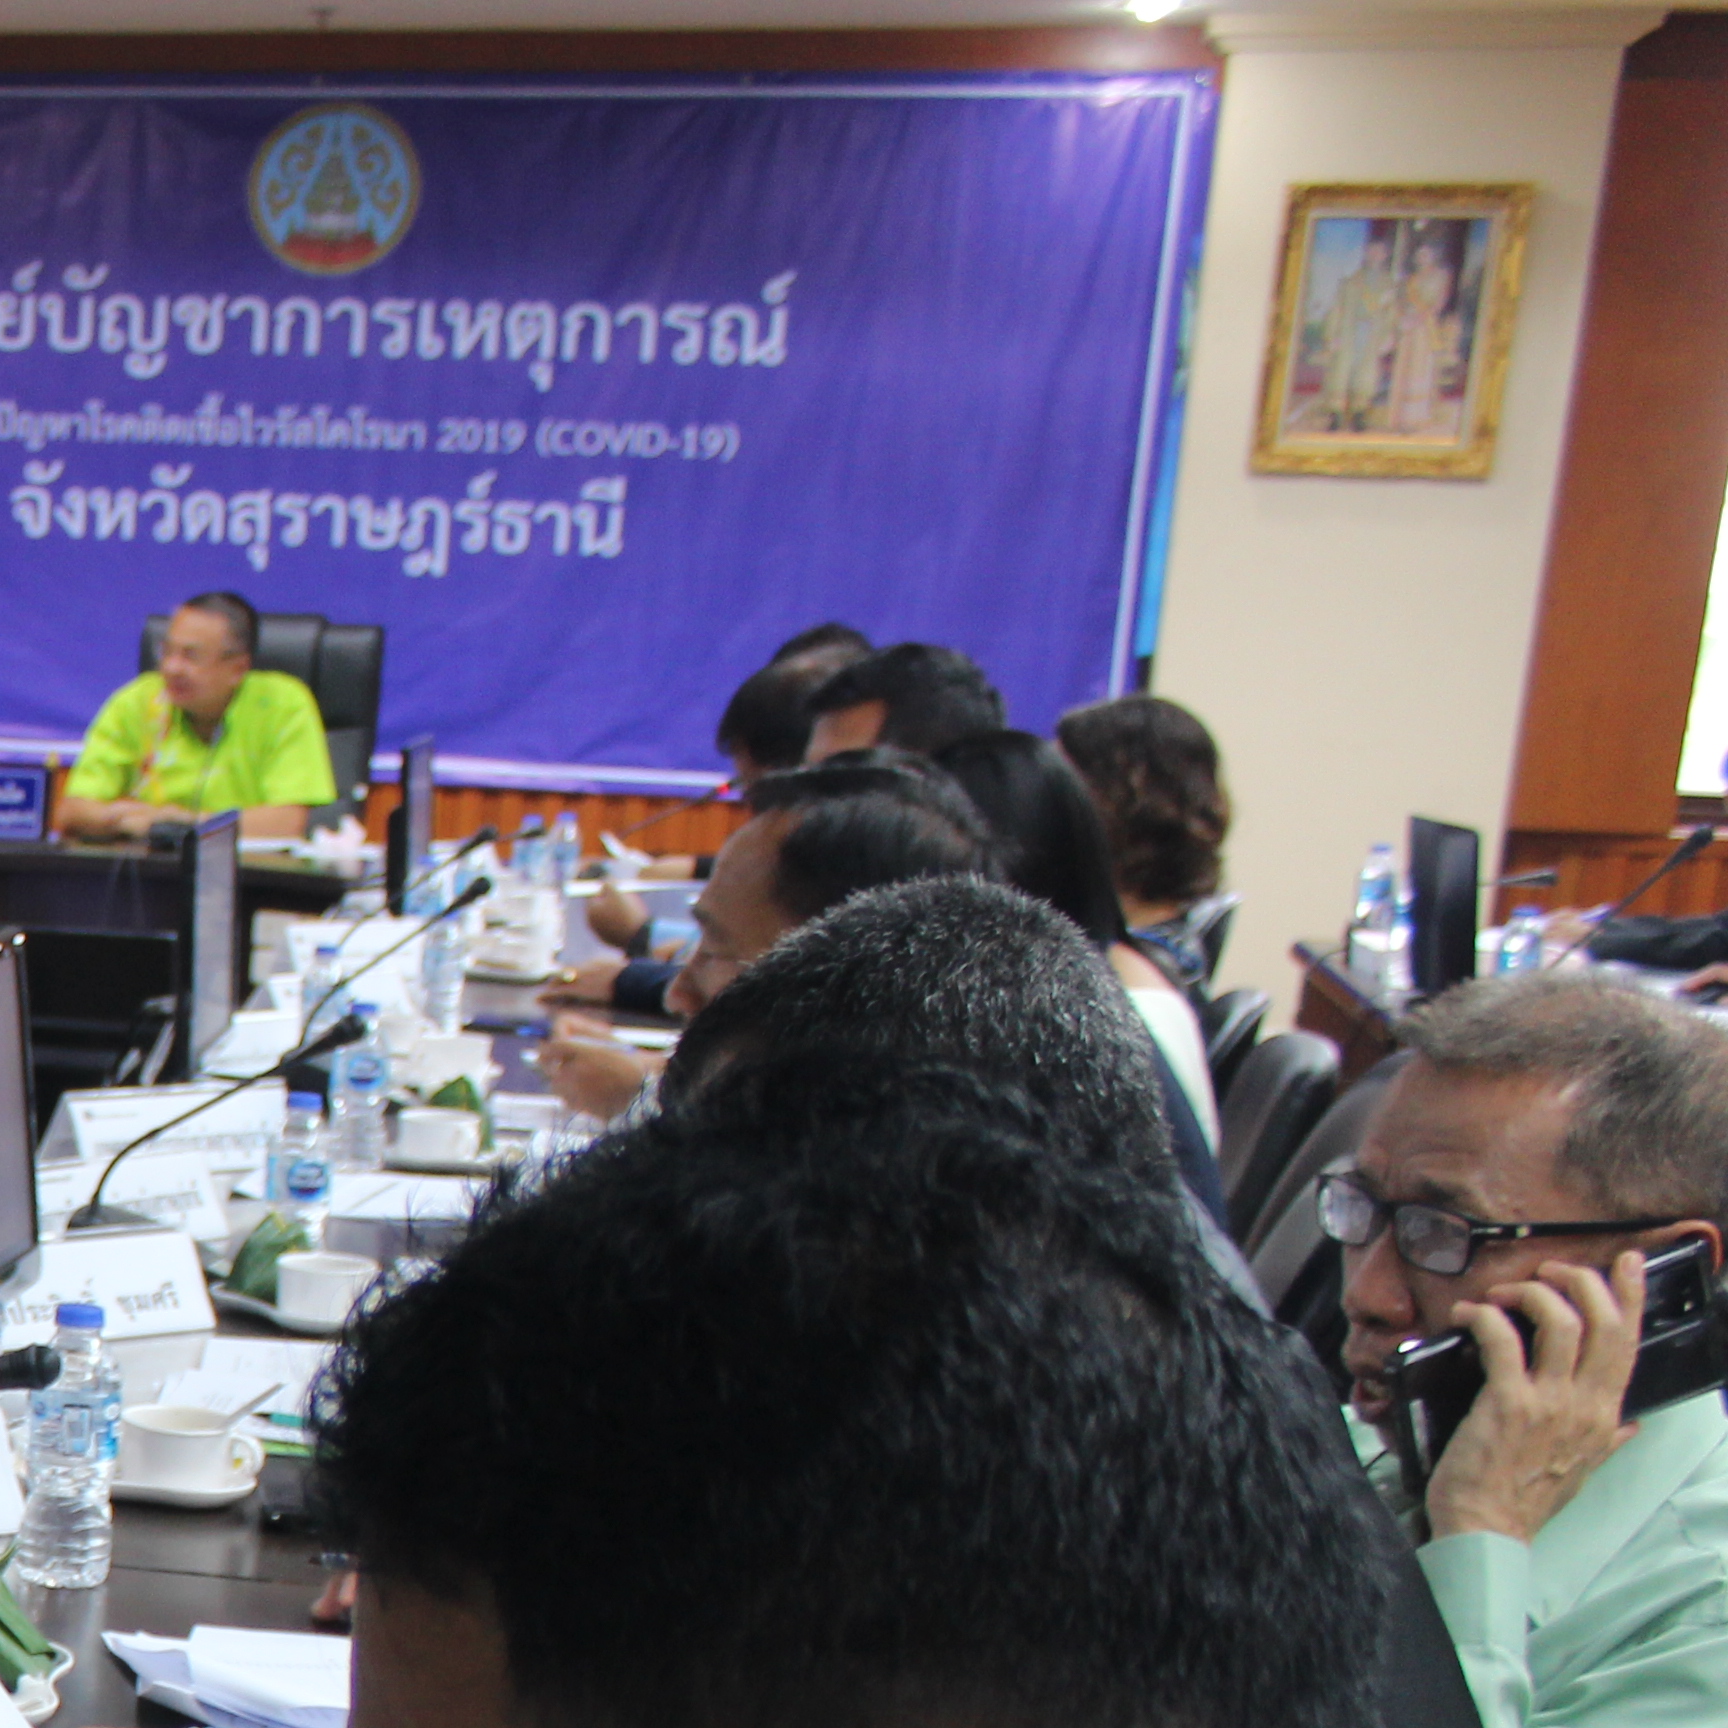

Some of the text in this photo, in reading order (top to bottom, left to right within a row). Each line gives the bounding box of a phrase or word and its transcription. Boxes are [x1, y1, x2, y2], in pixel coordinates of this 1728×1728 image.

[436, 416, 528, 456] 2019
[535, 416, 741, 463] (COVID-19)
[10, 458, 629, 578] จังหวัดสุราษฎร์ธานี
